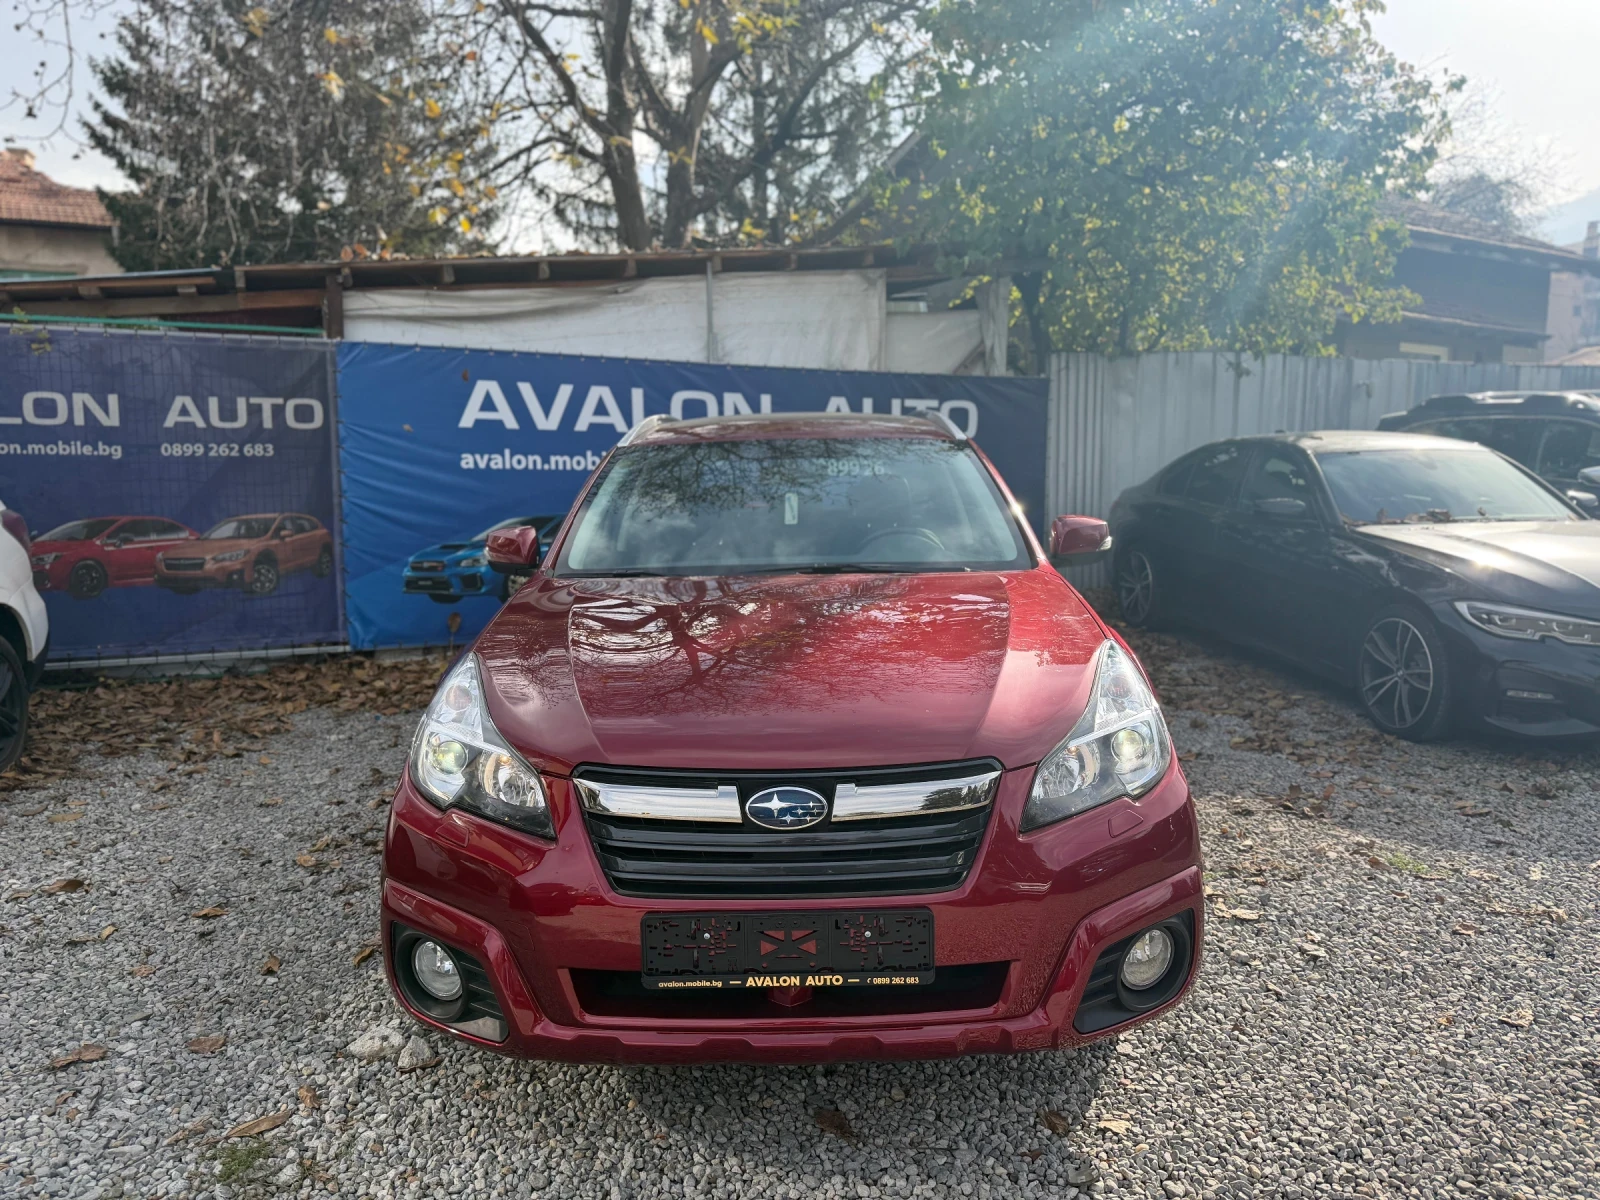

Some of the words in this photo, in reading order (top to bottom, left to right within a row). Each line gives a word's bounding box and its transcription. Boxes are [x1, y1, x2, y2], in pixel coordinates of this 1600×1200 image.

[163, 395, 324, 430] AUTO
[160, 443, 205, 457] 0899
[208, 443, 240, 457] 262
[243, 443, 275, 457] 683
[460, 448, 606, 471] avalon.mob
[658, 980, 723, 988] avalon.mobile.bg
[745, 976, 800, 987] AVALON
[805, 975, 843, 987] AUTO
[872, 977, 890, 985] 0899
[906, 976, 920, 984] 683
